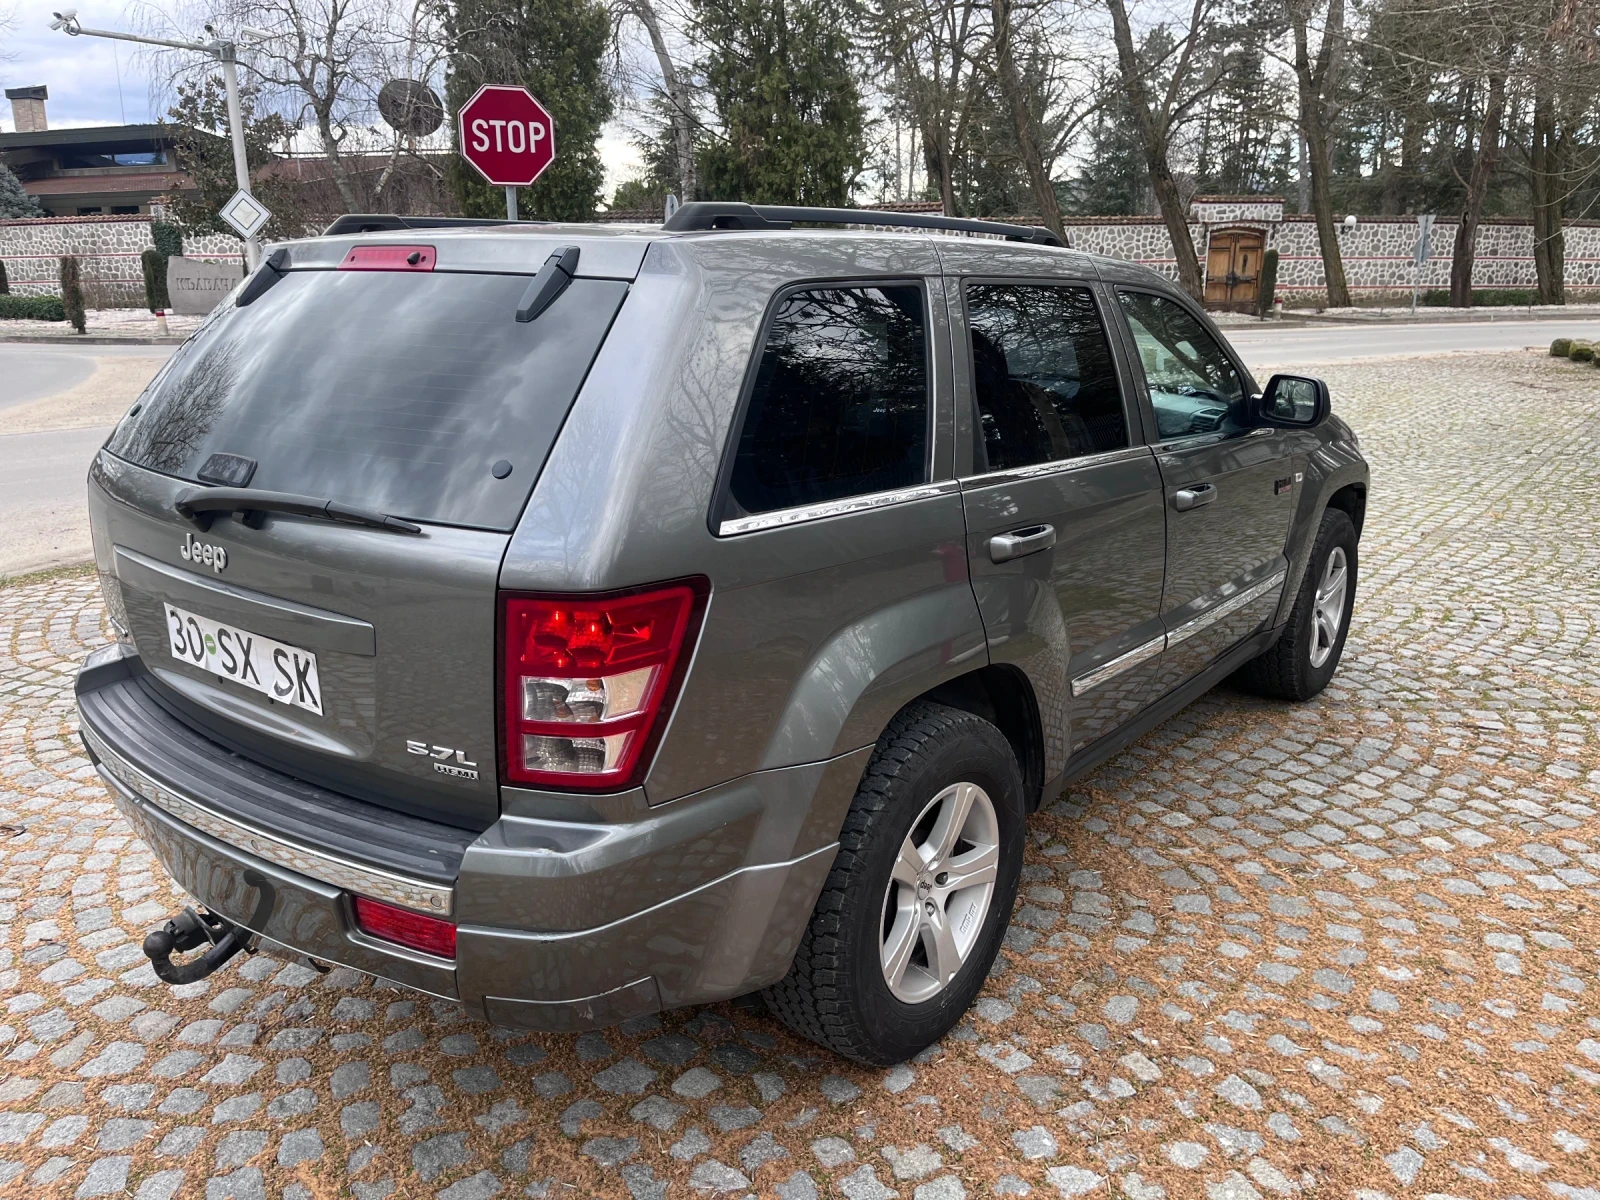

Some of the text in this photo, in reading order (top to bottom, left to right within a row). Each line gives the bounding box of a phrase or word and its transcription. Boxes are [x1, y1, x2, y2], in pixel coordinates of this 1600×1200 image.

[471, 118, 546, 153] STOP
[180, 532, 228, 574] Jeep
[217, 627, 261, 686] SX
[273, 647, 320, 709] SK
[406, 739, 478, 767] 5.7L
[435, 763, 478, 780] HEMI
